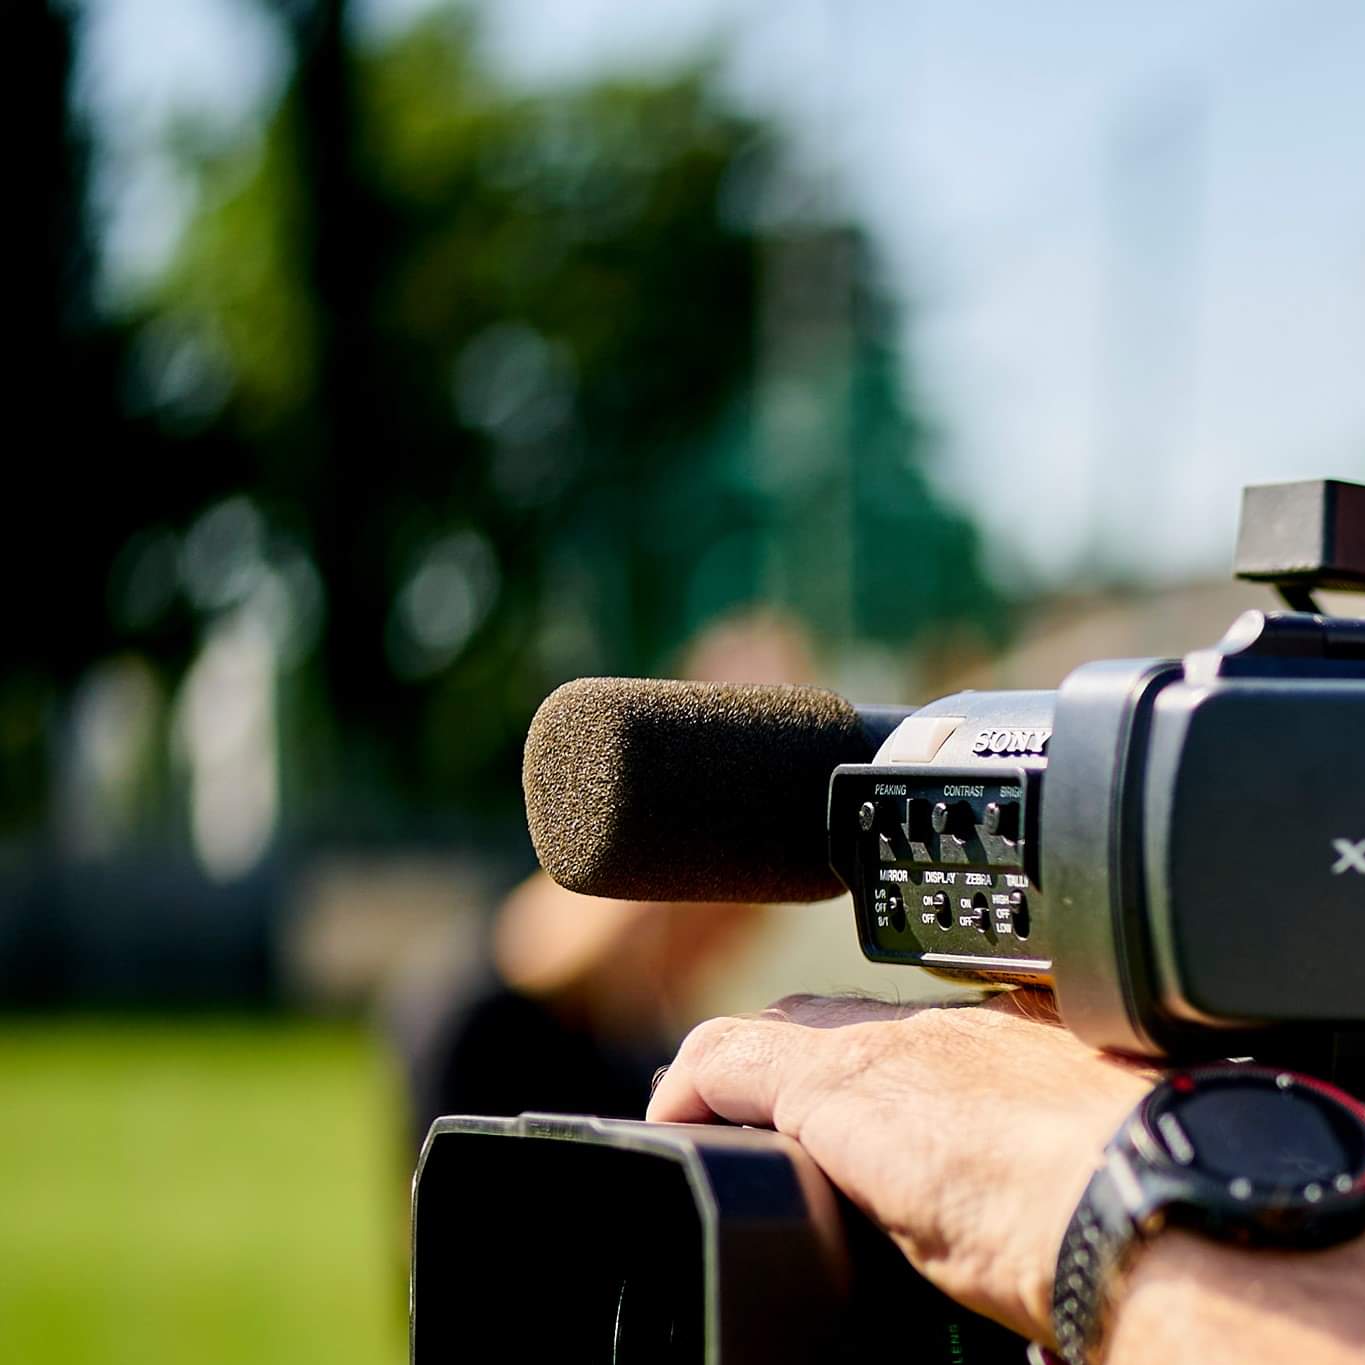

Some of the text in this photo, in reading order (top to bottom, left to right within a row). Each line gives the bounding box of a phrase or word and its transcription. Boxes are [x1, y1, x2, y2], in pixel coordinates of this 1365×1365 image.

[973, 729, 1052, 753] SONY
[875, 784, 907, 796] PEAKING
[943, 785, 985, 798] CONTRAST
[879, 869, 908, 882] MIRROR
[925, 871, 956, 885] DISPLAY
[965, 872, 992, 885] ZEBRA
[922, 895, 934, 906] ON
[960, 897, 971, 908] ON
[921, 913, 935, 924] OFF
[996, 908, 1010, 919] OFF
[959, 915, 972, 927] OFF
